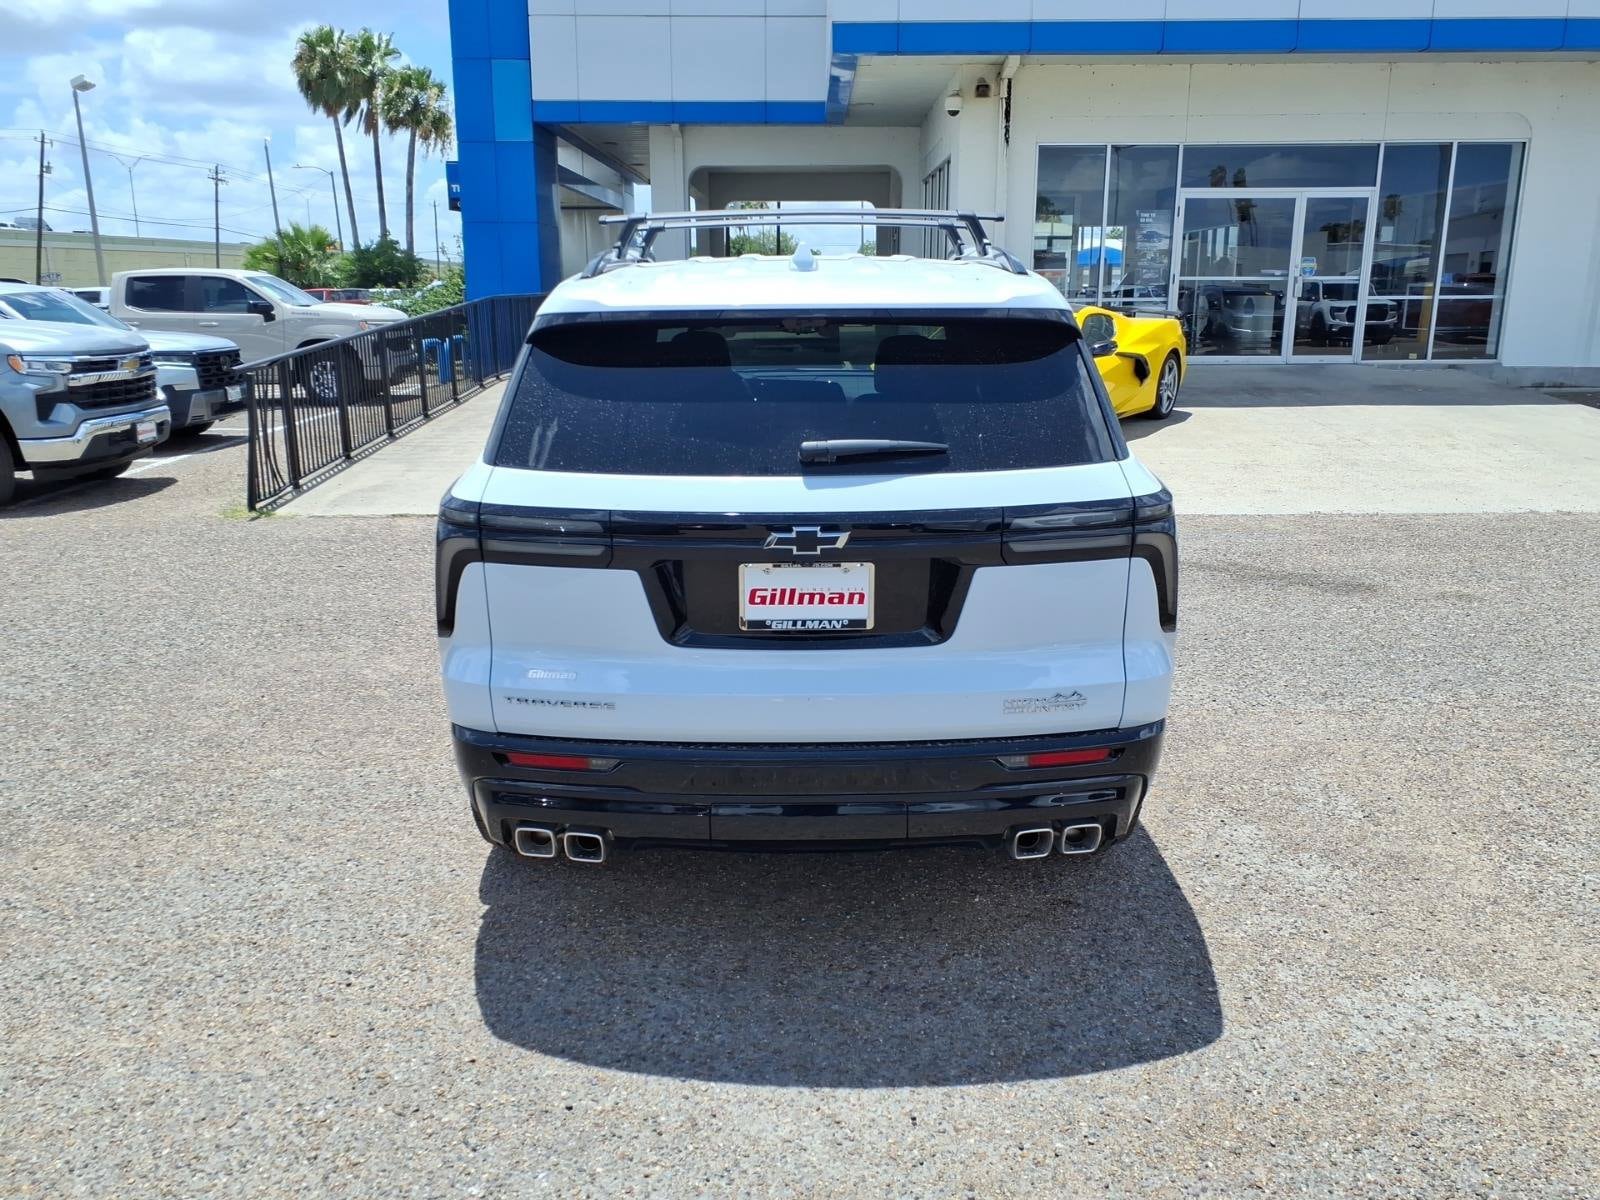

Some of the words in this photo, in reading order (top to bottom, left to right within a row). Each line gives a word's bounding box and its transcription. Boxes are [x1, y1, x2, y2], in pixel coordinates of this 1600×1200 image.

[748, 588, 866, 605] Gillman
[527, 669, 577, 680] Gillman
[504, 696, 616, 710] TRAVERSE
